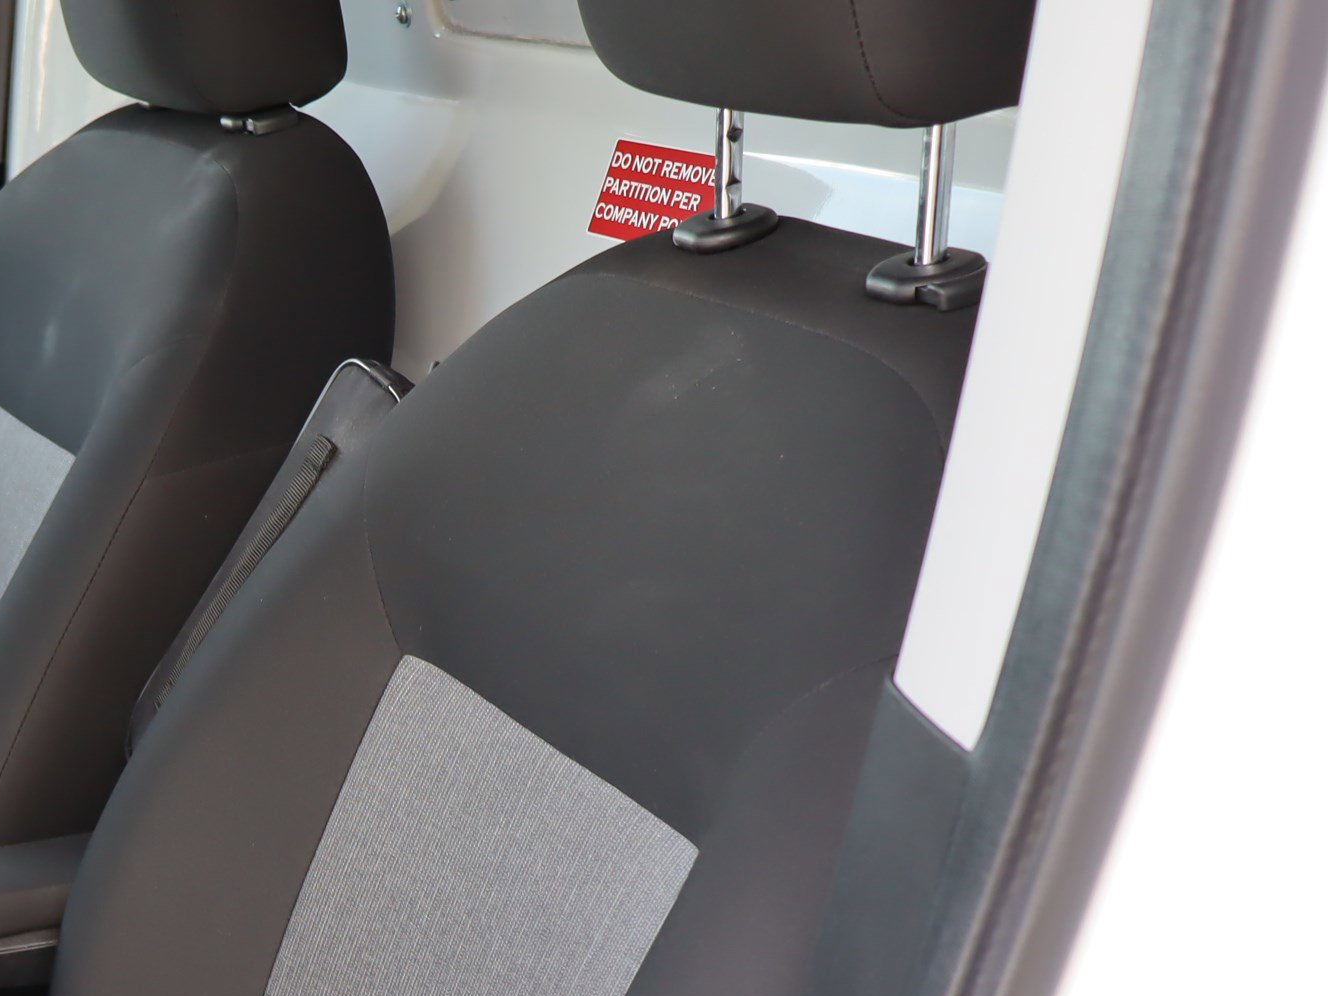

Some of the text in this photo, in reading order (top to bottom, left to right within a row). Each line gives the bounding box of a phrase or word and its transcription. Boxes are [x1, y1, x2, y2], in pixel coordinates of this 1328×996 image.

[612, 151, 632, 169] DO
[632, 155, 662, 175] NOT
[603, 177, 701, 212] PARTITION PER
[595, 203, 659, 231] COMPANY
